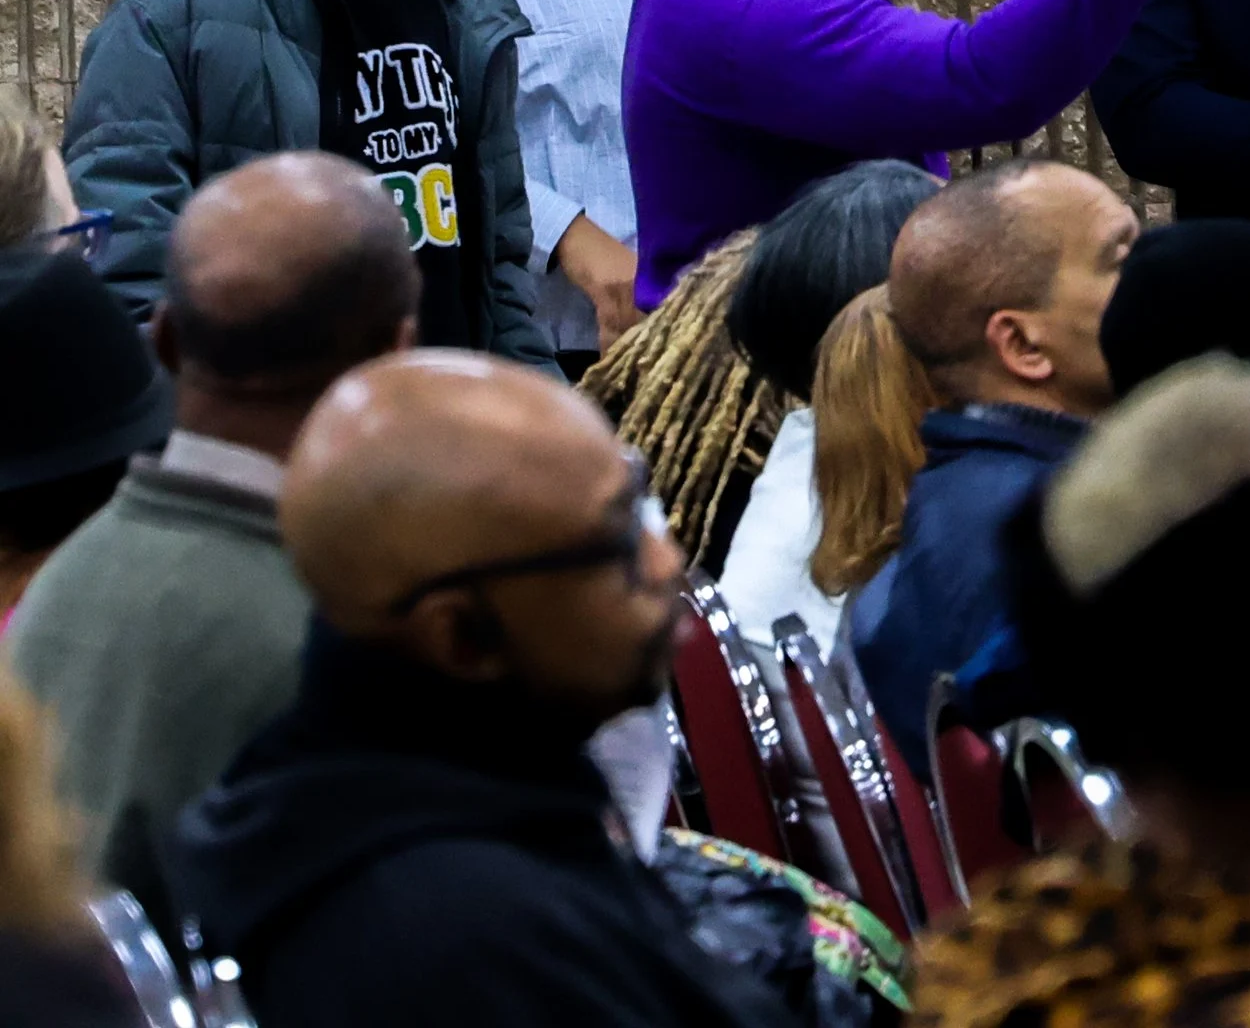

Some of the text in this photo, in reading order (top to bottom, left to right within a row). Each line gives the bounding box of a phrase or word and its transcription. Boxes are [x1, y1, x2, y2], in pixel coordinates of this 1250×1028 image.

[368, 121, 439, 164] TO MY
[374, 162, 460, 251] BC
